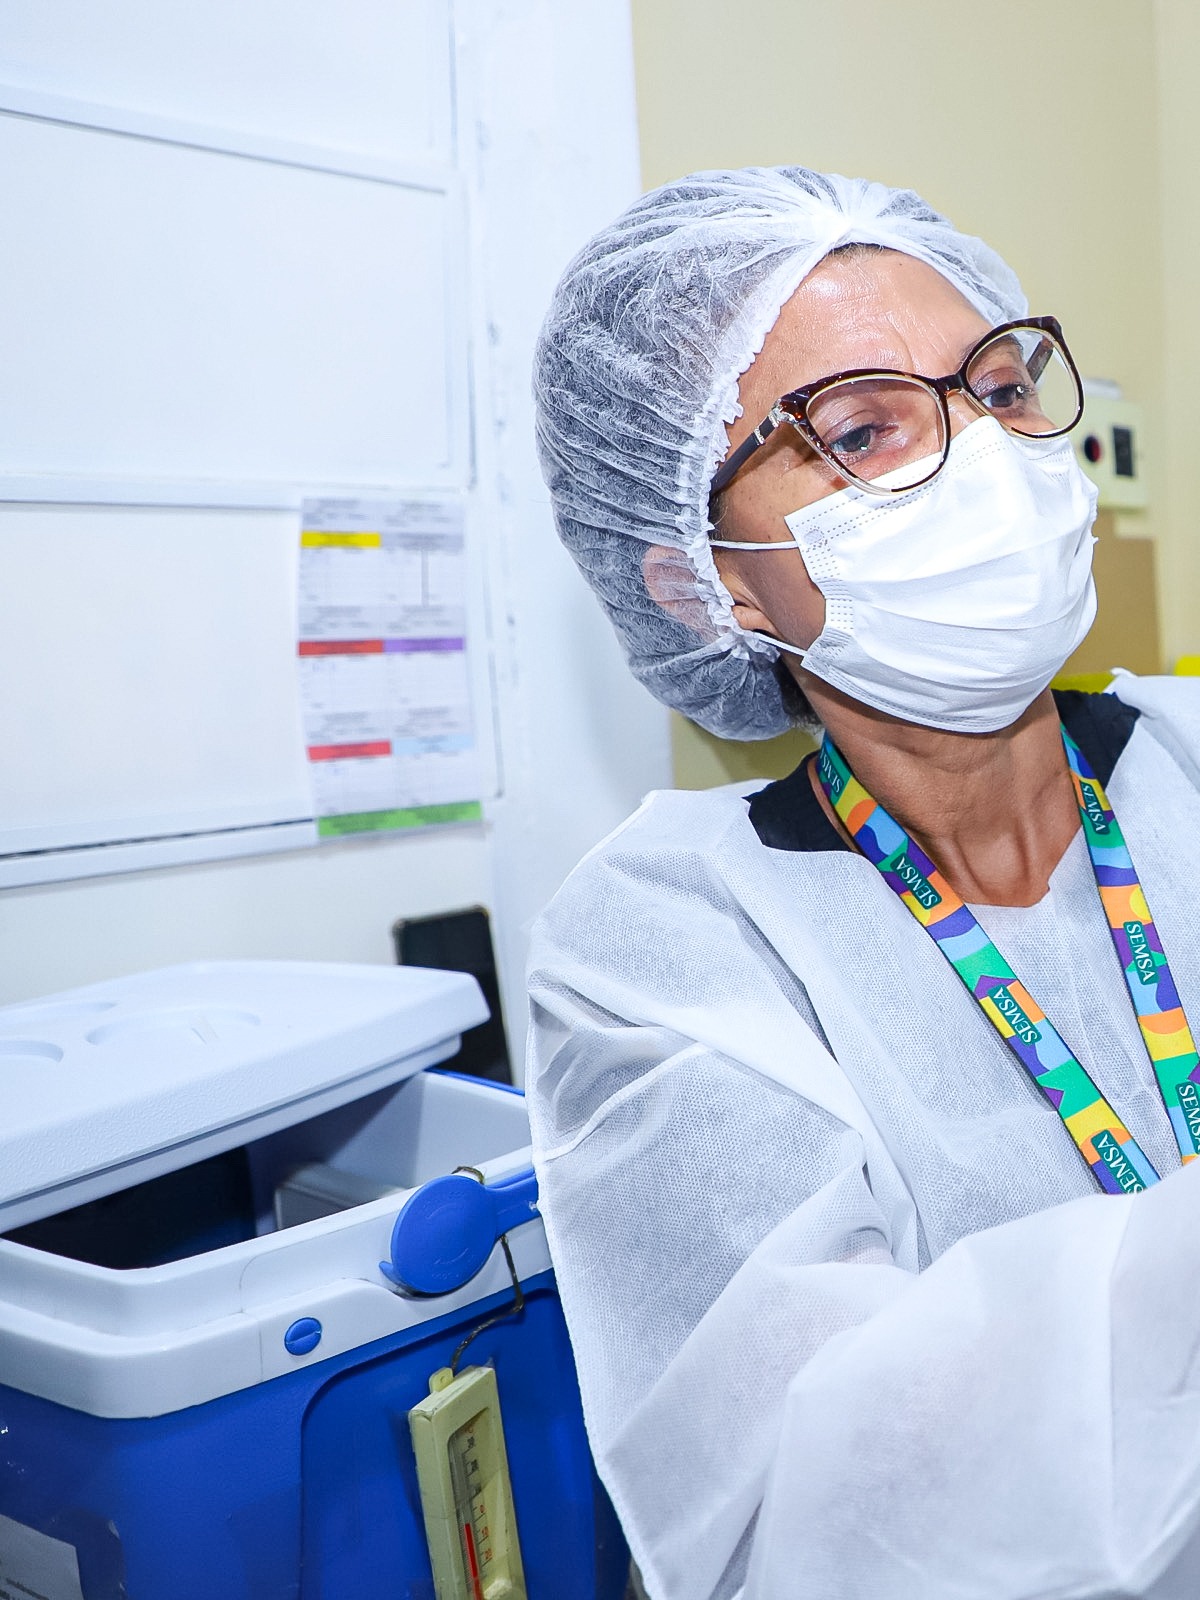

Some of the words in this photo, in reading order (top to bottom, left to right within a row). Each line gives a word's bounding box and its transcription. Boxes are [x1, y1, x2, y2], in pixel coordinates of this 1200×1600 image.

[1082, 783, 1107, 832] SEMSA
[896, 856, 938, 908] SEMSA
[1126, 923, 1156, 983] SEMSA
[993, 986, 1038, 1043] SEMSA
